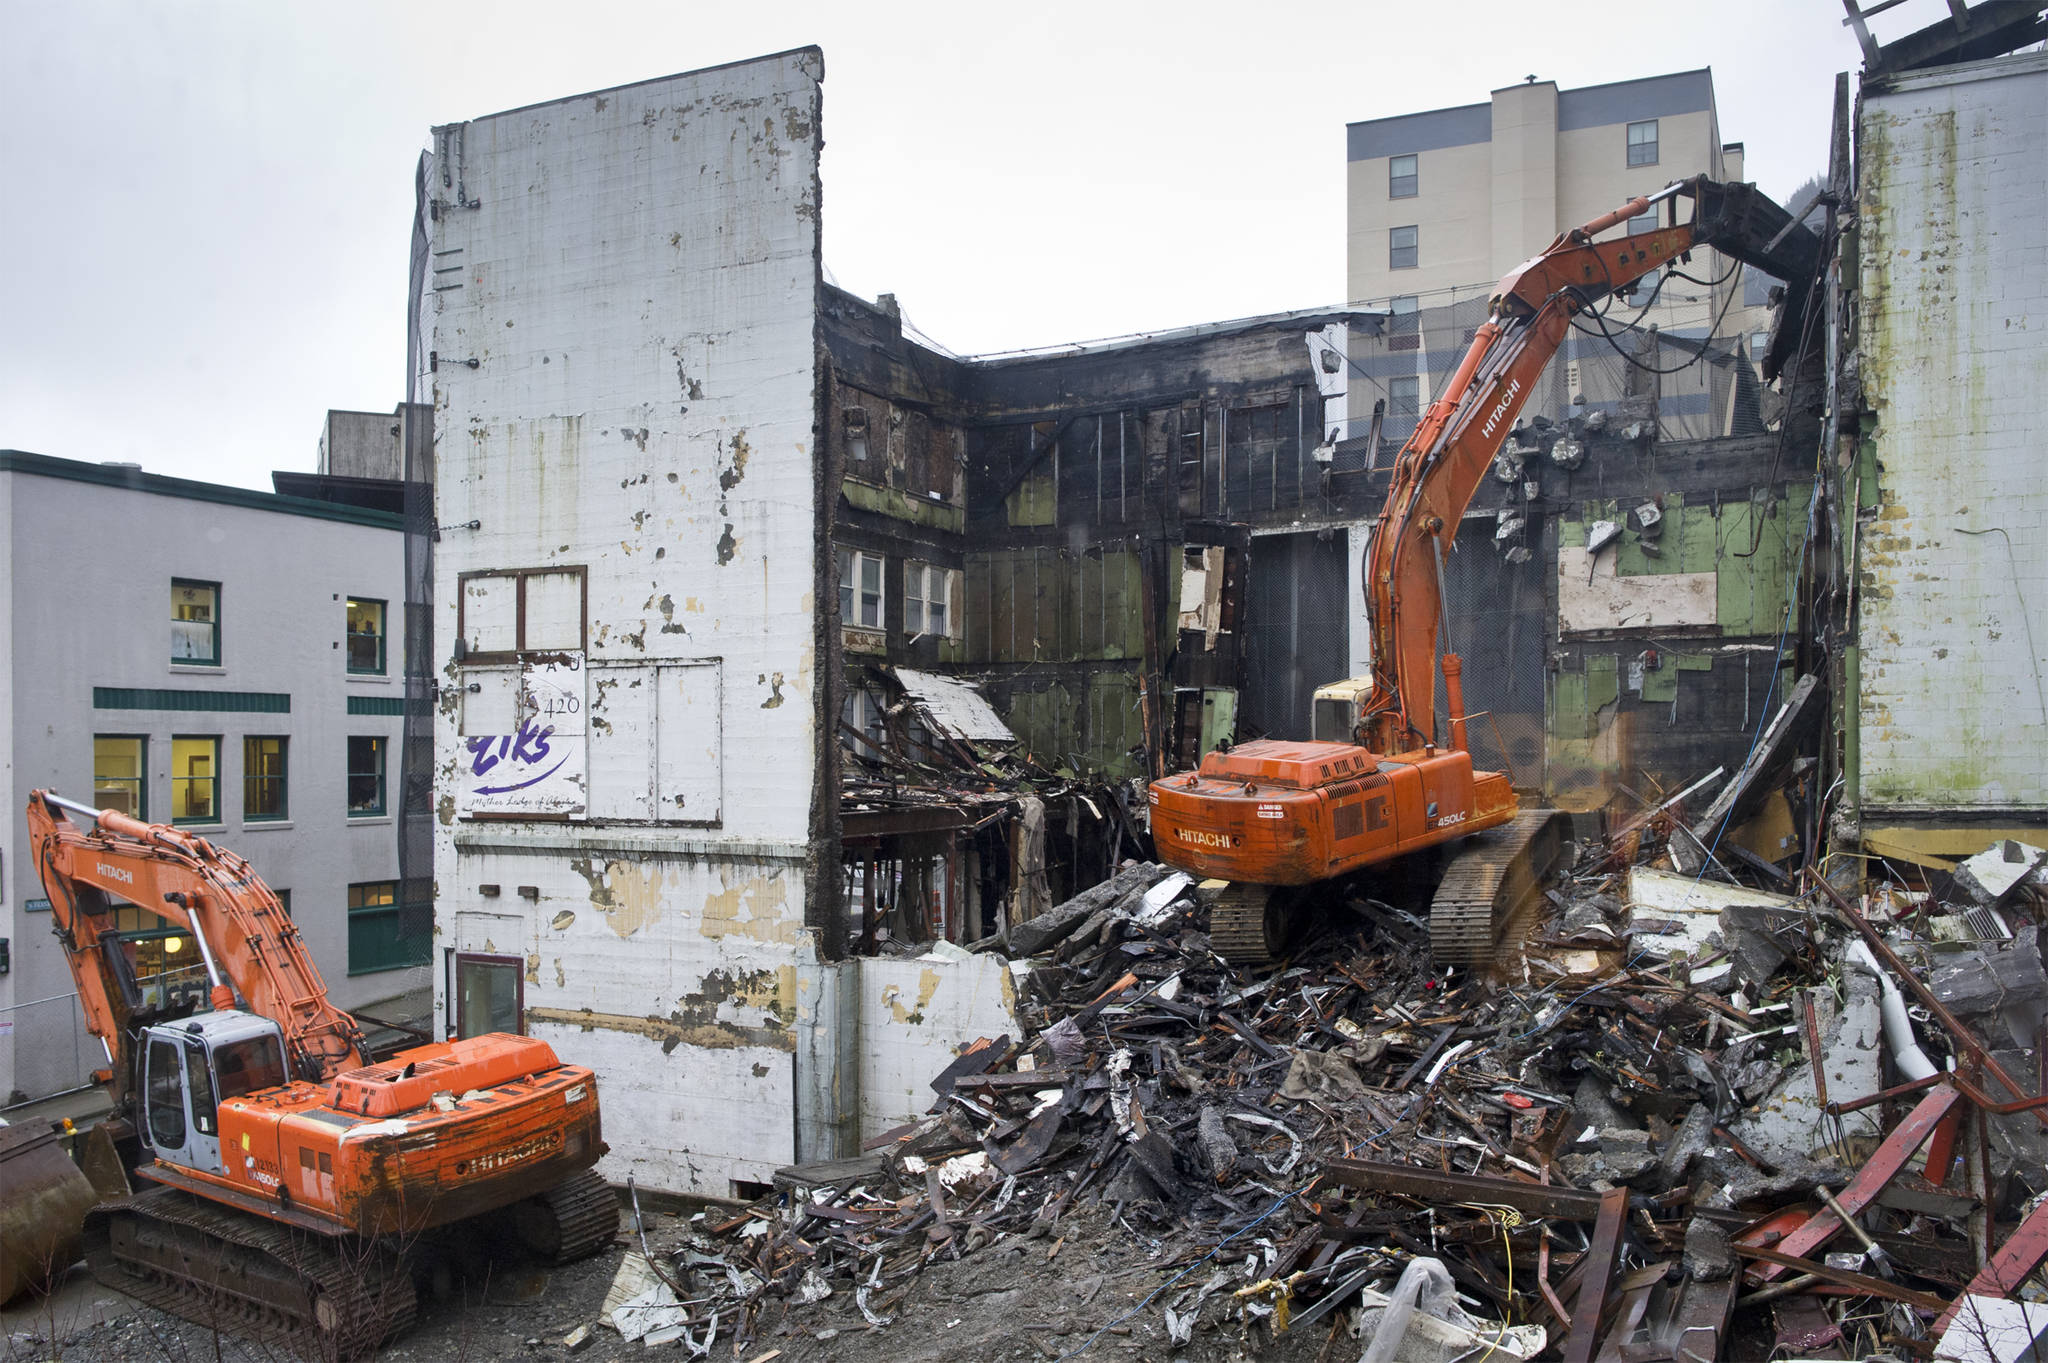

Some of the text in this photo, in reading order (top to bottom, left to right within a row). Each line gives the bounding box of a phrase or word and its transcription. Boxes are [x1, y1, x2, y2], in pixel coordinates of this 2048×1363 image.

[1482, 378, 1521, 439] HITACHI
[544, 697, 580, 718] 420
[1179, 828, 1230, 849] HITACHI
[96, 862, 133, 884] HITACHI
